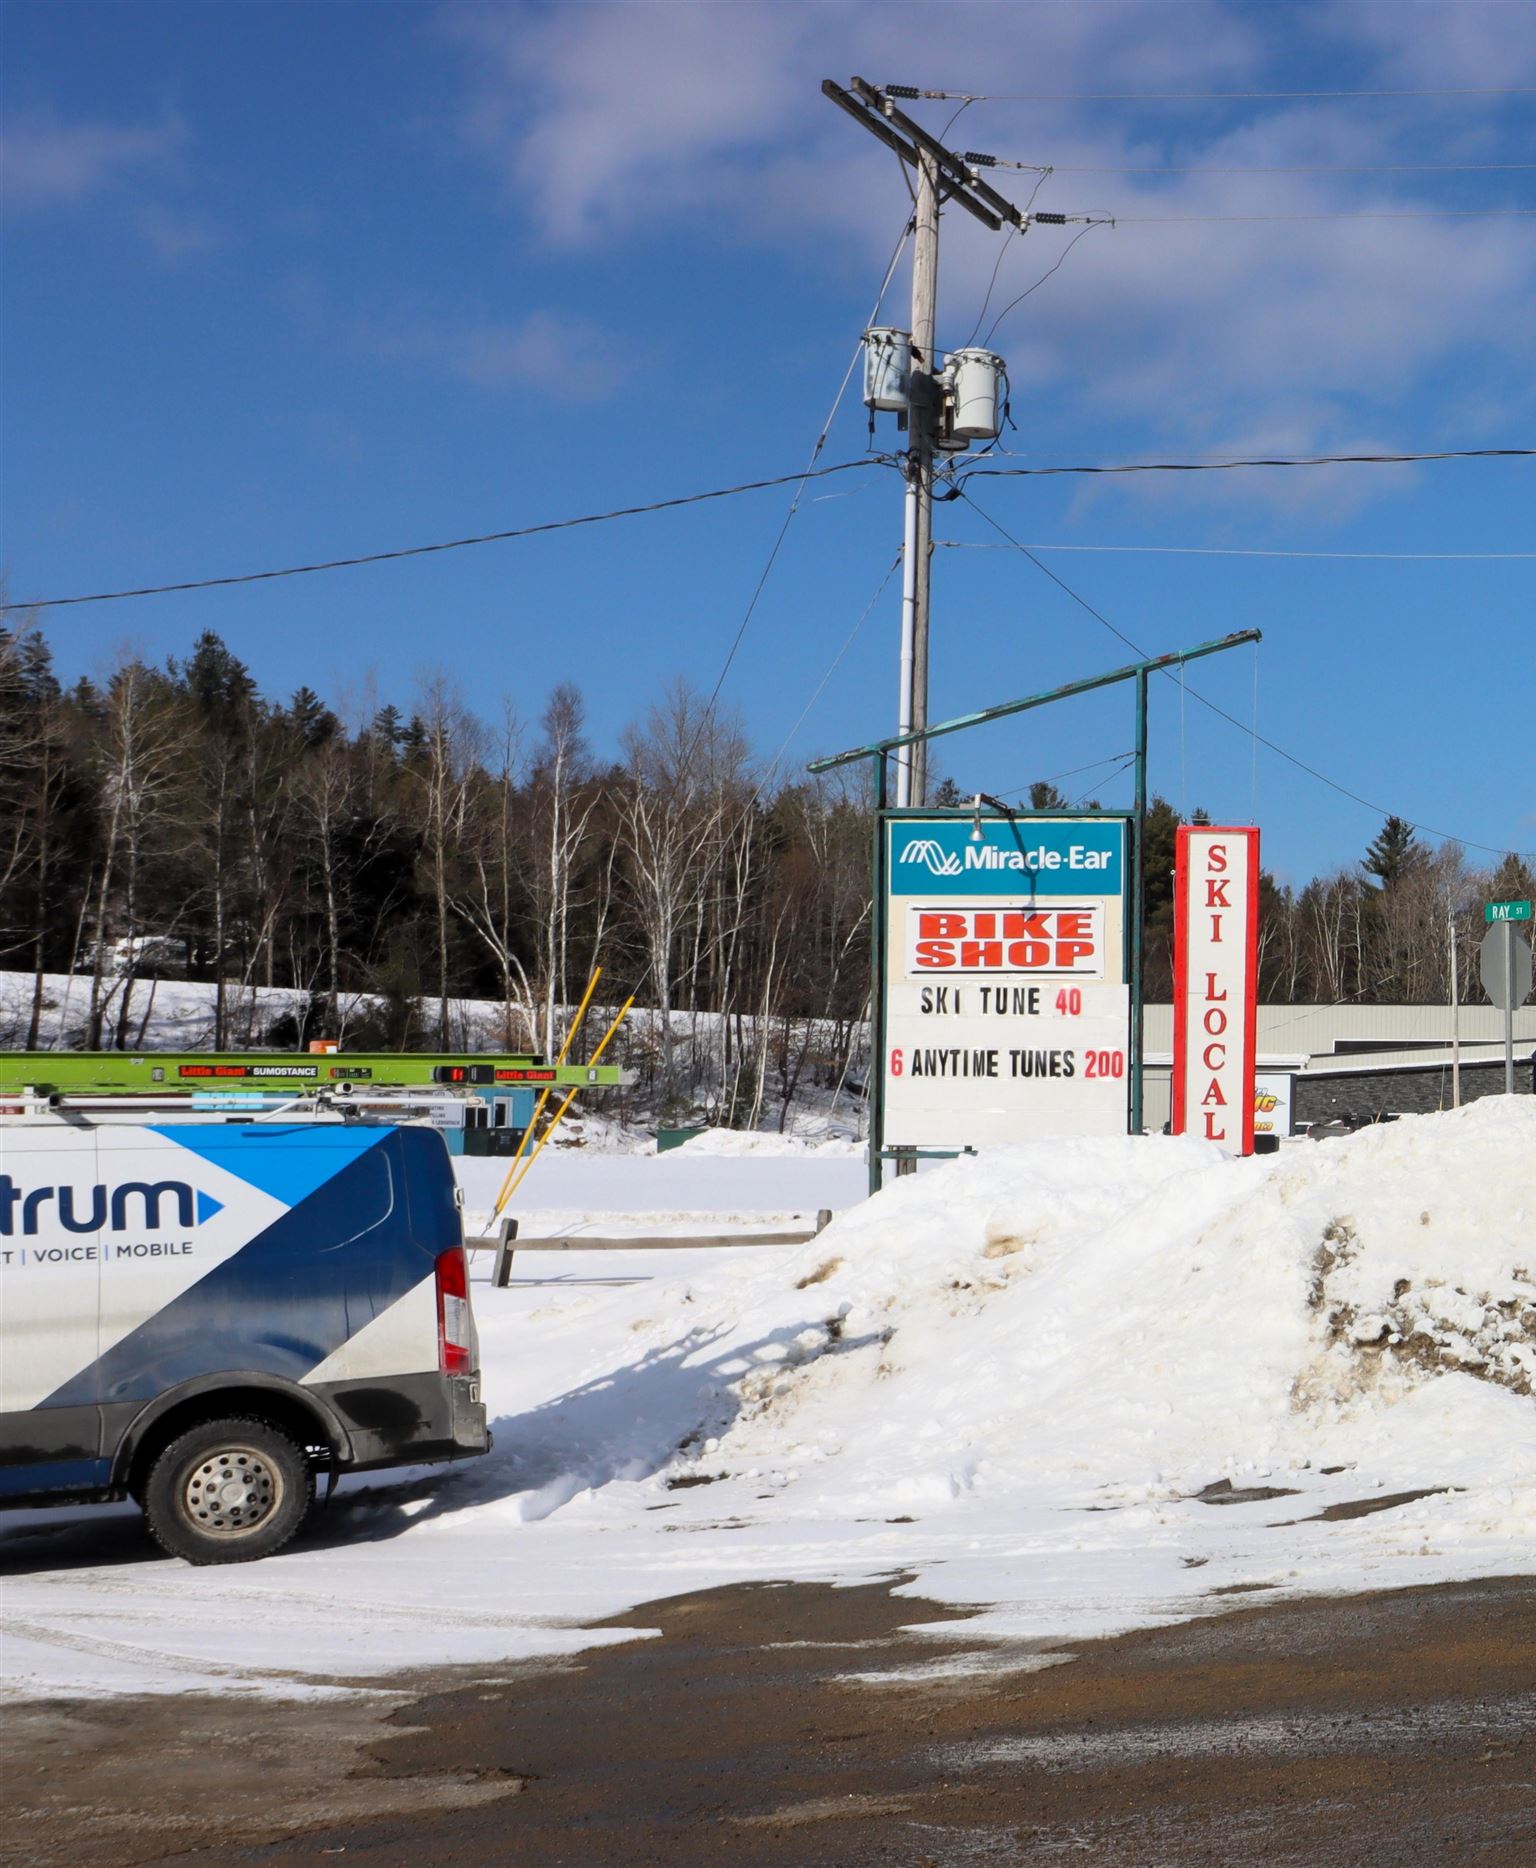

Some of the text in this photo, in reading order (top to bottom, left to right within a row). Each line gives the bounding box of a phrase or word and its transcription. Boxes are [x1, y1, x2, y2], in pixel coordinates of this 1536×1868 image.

[964, 845, 1112, 870] Miracle-Ear
[1204, 844, 1232, 943] SKI
[1492, 905, 1510, 919] RAY
[919, 913, 1093, 939] BIKE
[915, 940, 1095, 967] SHOP
[921, 986, 1082, 1016] SKI TUNE 40
[891, 1048, 1124, 1078] 6 ANYTIME TUNES 200
[1201, 972, 1228, 1141] LOCAL
[253, 1066, 317, 1077] SUMOSTANCE
[33, 1247, 98, 1263] VOICE
[117, 1242, 193, 1258] MOBILE
